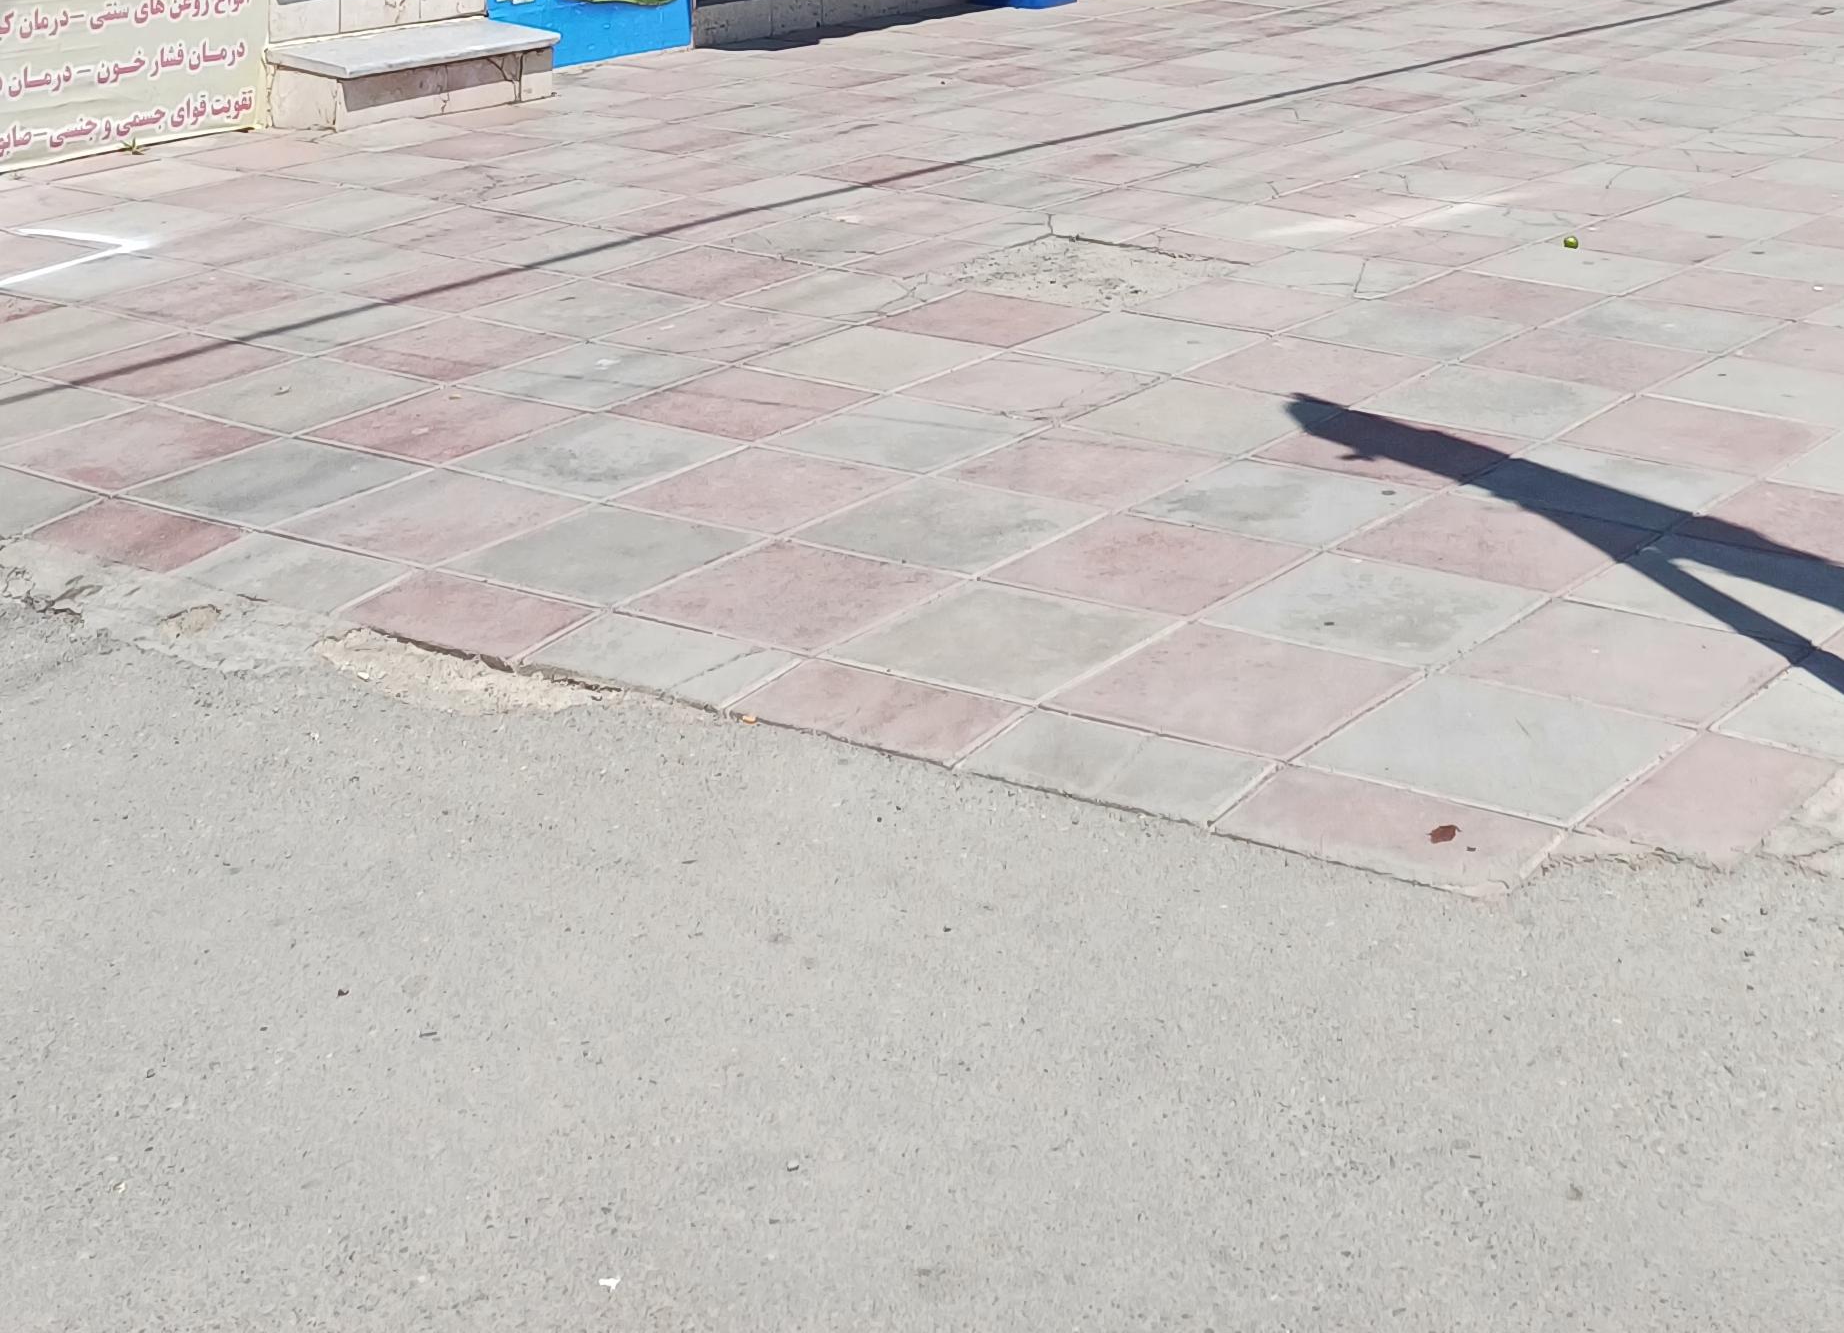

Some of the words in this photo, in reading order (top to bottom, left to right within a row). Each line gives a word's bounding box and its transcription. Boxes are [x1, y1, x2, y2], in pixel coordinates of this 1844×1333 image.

[90, 2, 129, 30] سنتی
[97, 51, 146, 84] خون
[150, 43, 185, 77] فشار
[188, 41, 246, 71] درمان
[8, 66, 72, 98] درمان
[171, 95, 207, 128] قوای
[211, 90, 254, 120] تقویت
[49, 117, 98, 148] جنسی
[102, 119, 112, 141] و
[116, 107, 166, 137] جسمی
